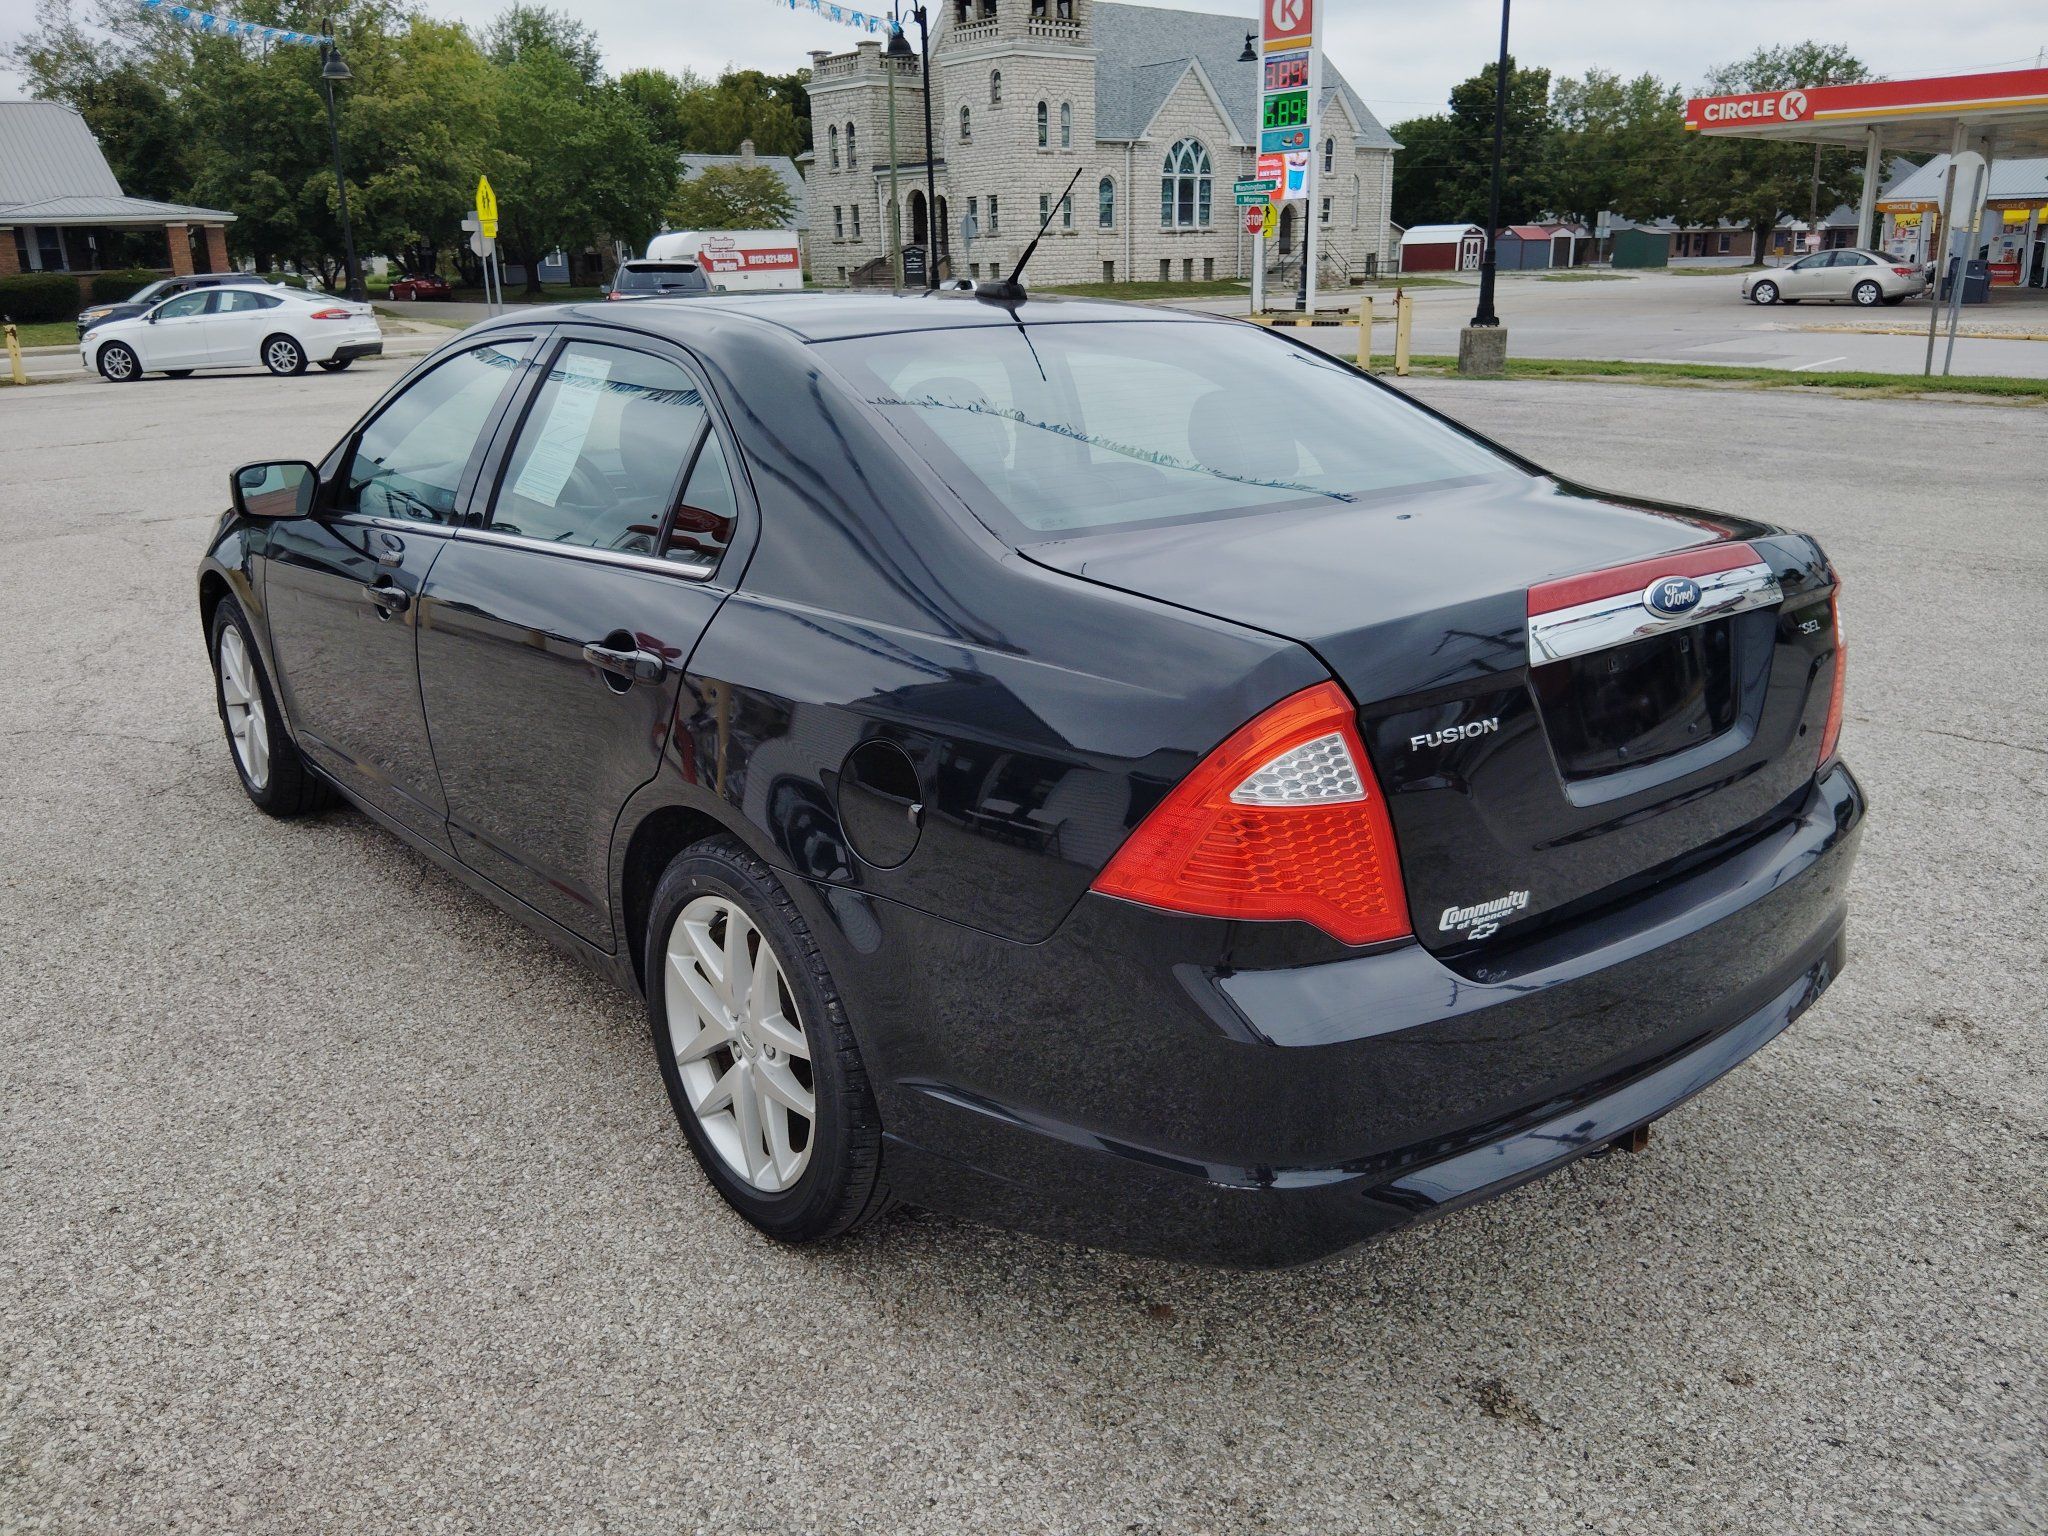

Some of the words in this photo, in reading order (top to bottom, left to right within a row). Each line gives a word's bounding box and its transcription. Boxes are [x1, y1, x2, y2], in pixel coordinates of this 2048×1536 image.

[1704, 99, 1775, 121] CIRCLE
[1782, 94, 1805, 119] K
[1243, 195, 1264, 205] Morgan
[1246, 214, 1263, 226] STOP
[713, 260, 738, 271] Service
[1664, 582, 1695, 608] Ford
[1803, 619, 1821, 635] SEL
[1410, 717, 1499, 752] FUSION
[1438, 890, 1530, 931] Community
[1457, 919, 1471, 930] of
[1471, 907, 1515, 926] Spencer
